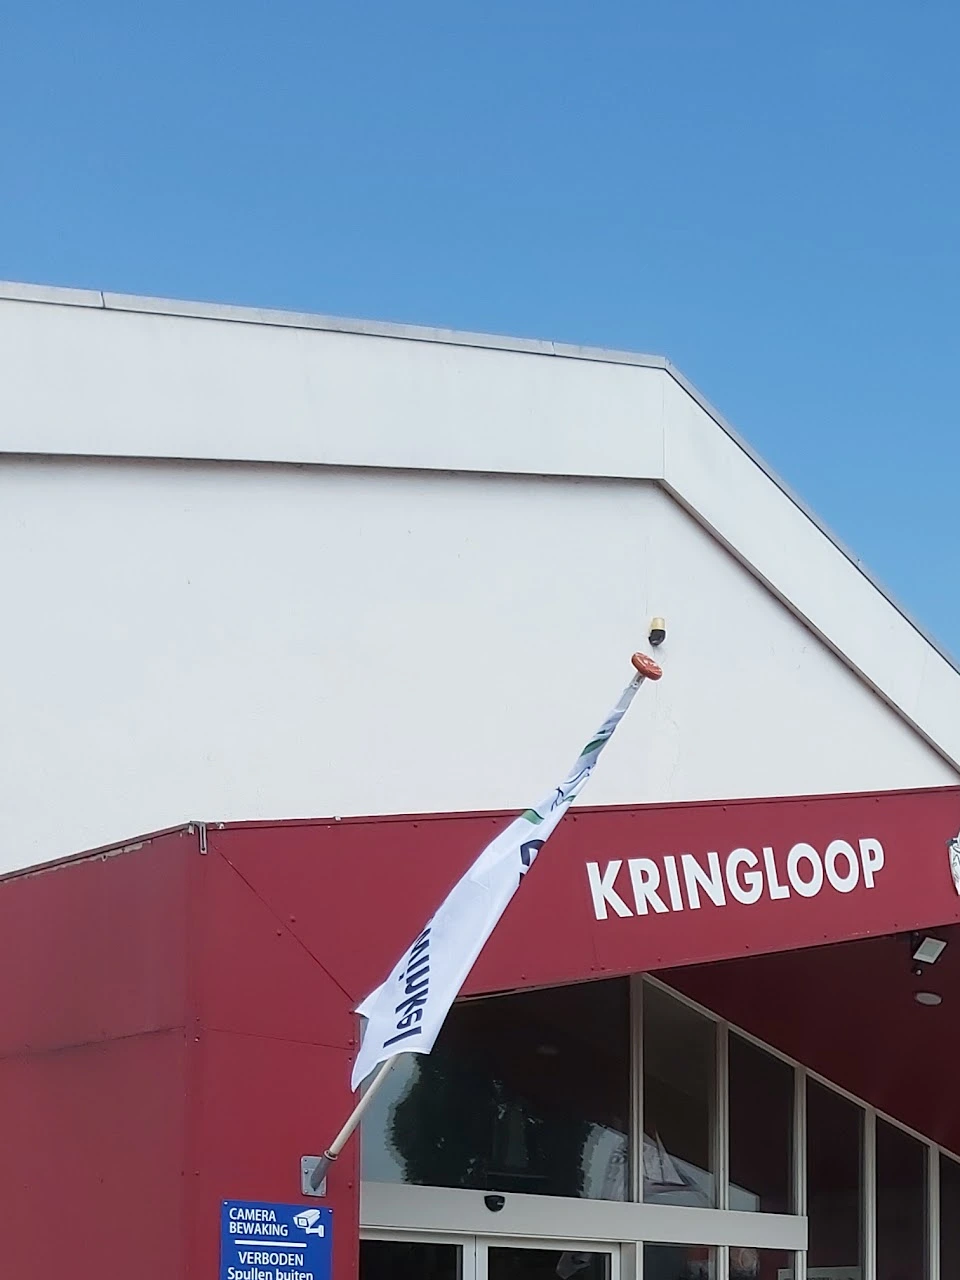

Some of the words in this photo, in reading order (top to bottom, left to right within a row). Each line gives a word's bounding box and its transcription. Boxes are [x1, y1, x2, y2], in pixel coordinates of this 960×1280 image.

[586, 838, 884, 921] KRINGLOOP
[229, 1208, 276, 1222] CAMERA
[229, 1222, 288, 1236] BEWAKING
[238, 1251, 304, 1266] VERBODEN
